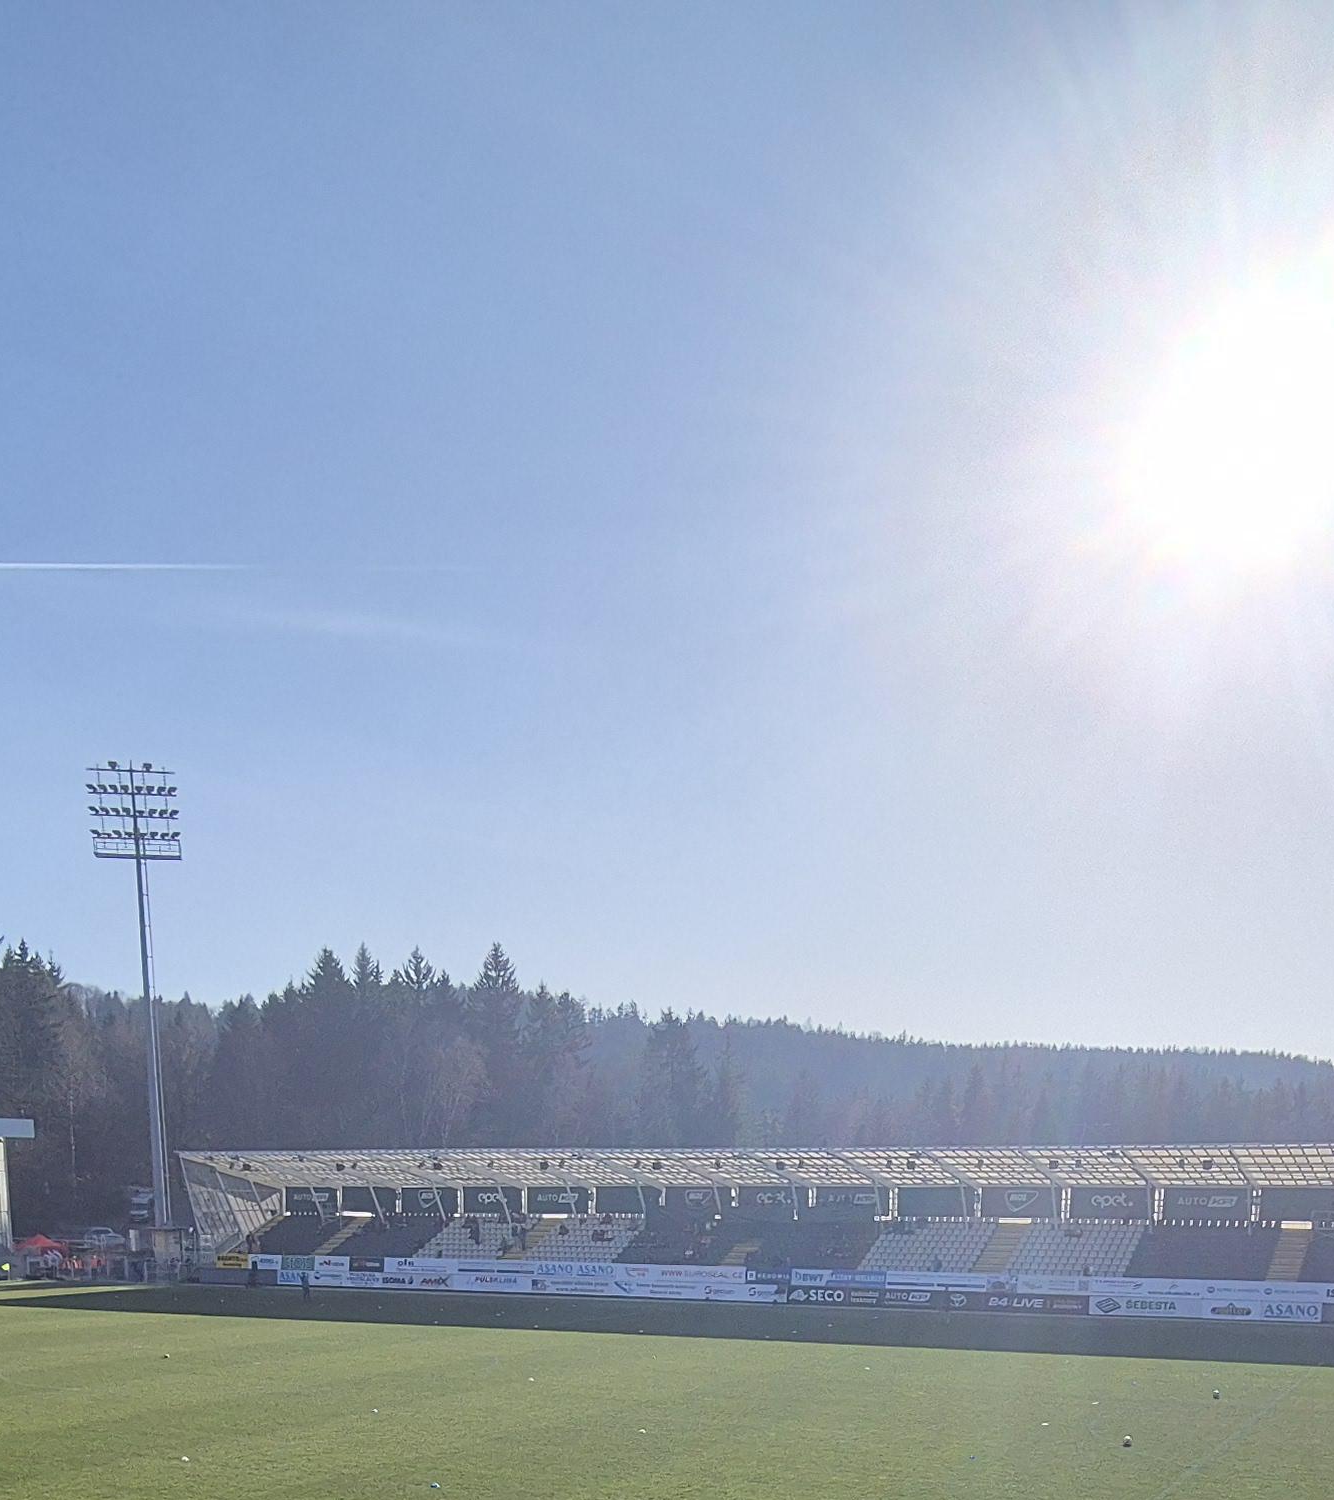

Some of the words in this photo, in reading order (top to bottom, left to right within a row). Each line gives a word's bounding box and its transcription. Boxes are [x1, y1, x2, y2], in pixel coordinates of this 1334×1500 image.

[1177, 1196, 1208, 1206] AUTO
[537, 1263, 573, 1274] ASANO
[576, 1265, 614, 1276] ASANO
[808, 1289, 845, 1302] SECO
[884, 1292, 908, 1300] AUTO
[1125, 1299, 1177, 1311] ŠEBESTA
[1264, 1304, 1318, 1316] ASANO
